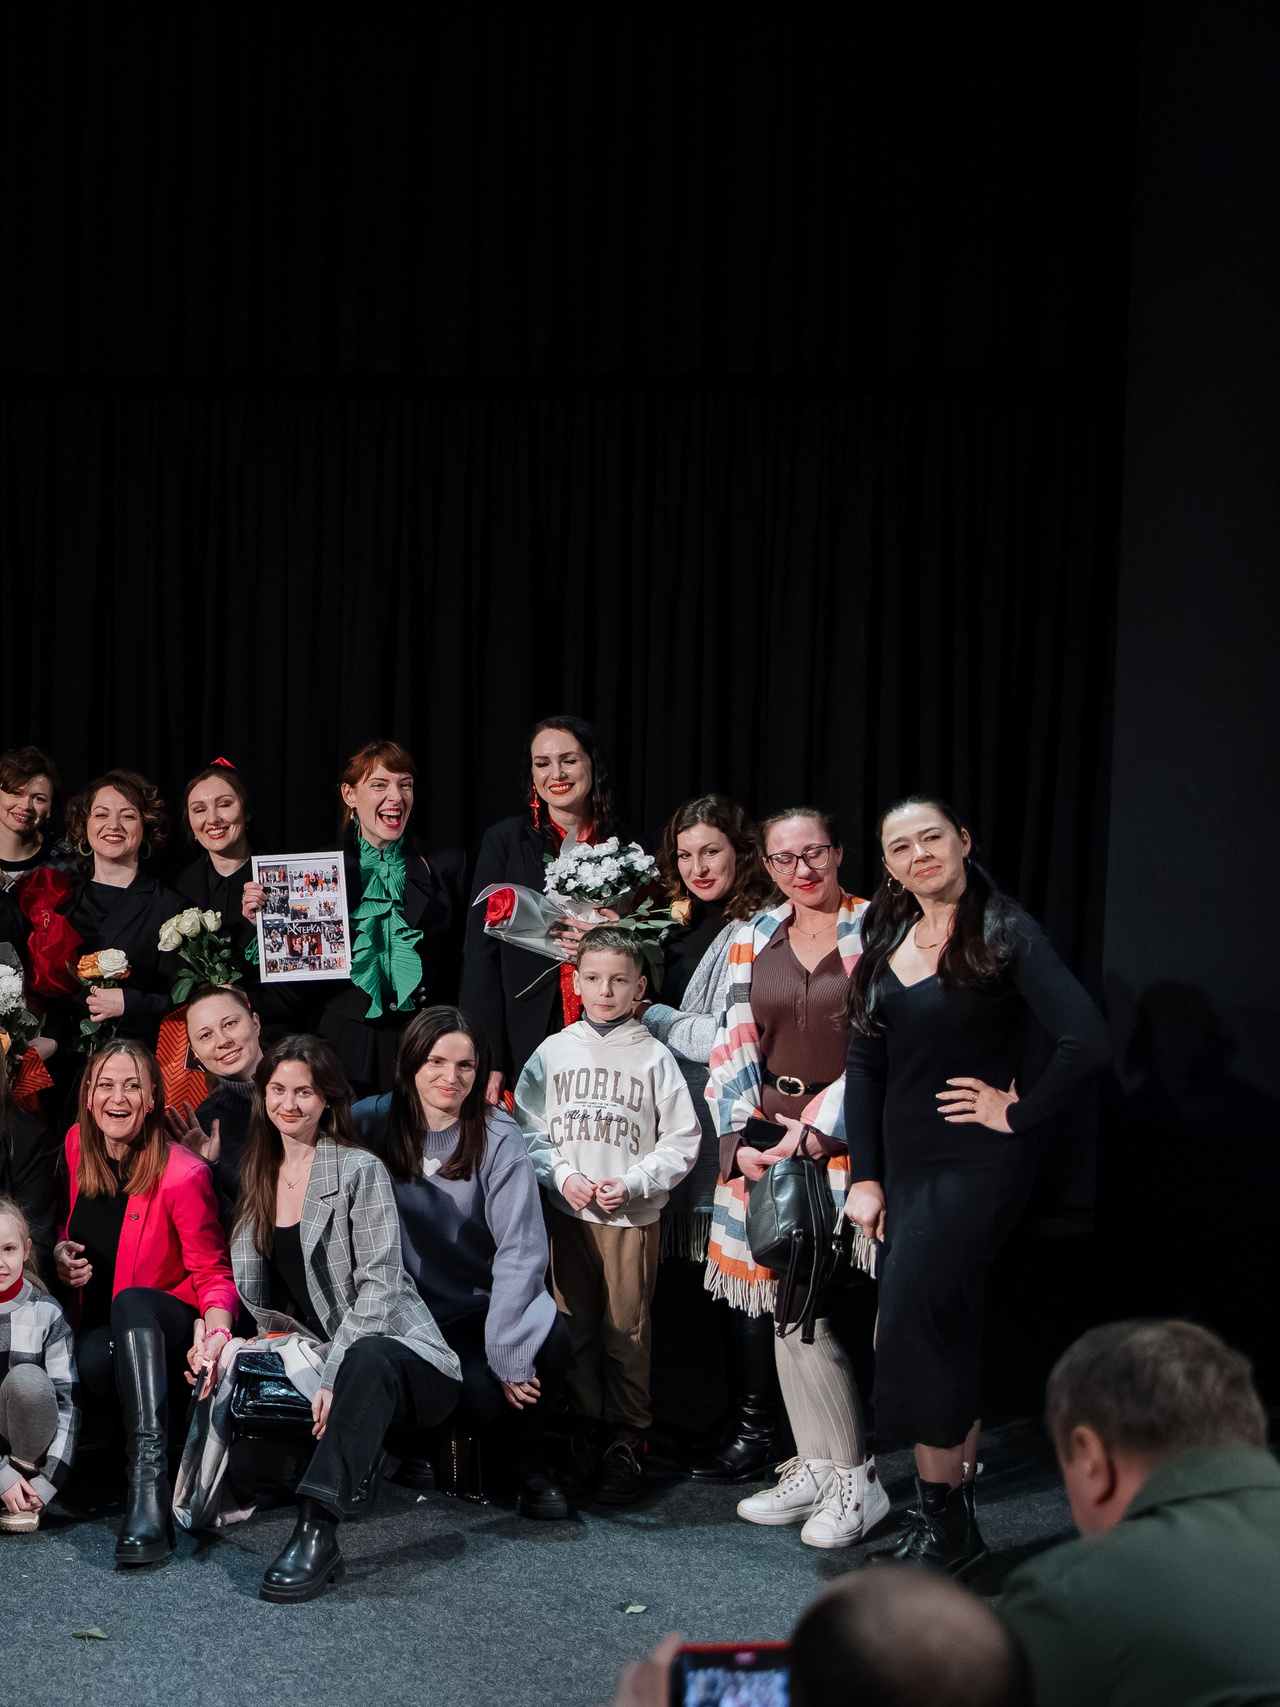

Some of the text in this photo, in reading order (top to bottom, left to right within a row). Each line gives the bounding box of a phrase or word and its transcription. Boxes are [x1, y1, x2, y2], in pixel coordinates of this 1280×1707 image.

[553, 1068, 644, 1113] WORLD
[550, 1109, 640, 1156] CHAMPS
[564, 1108, 626, 1125] College League
